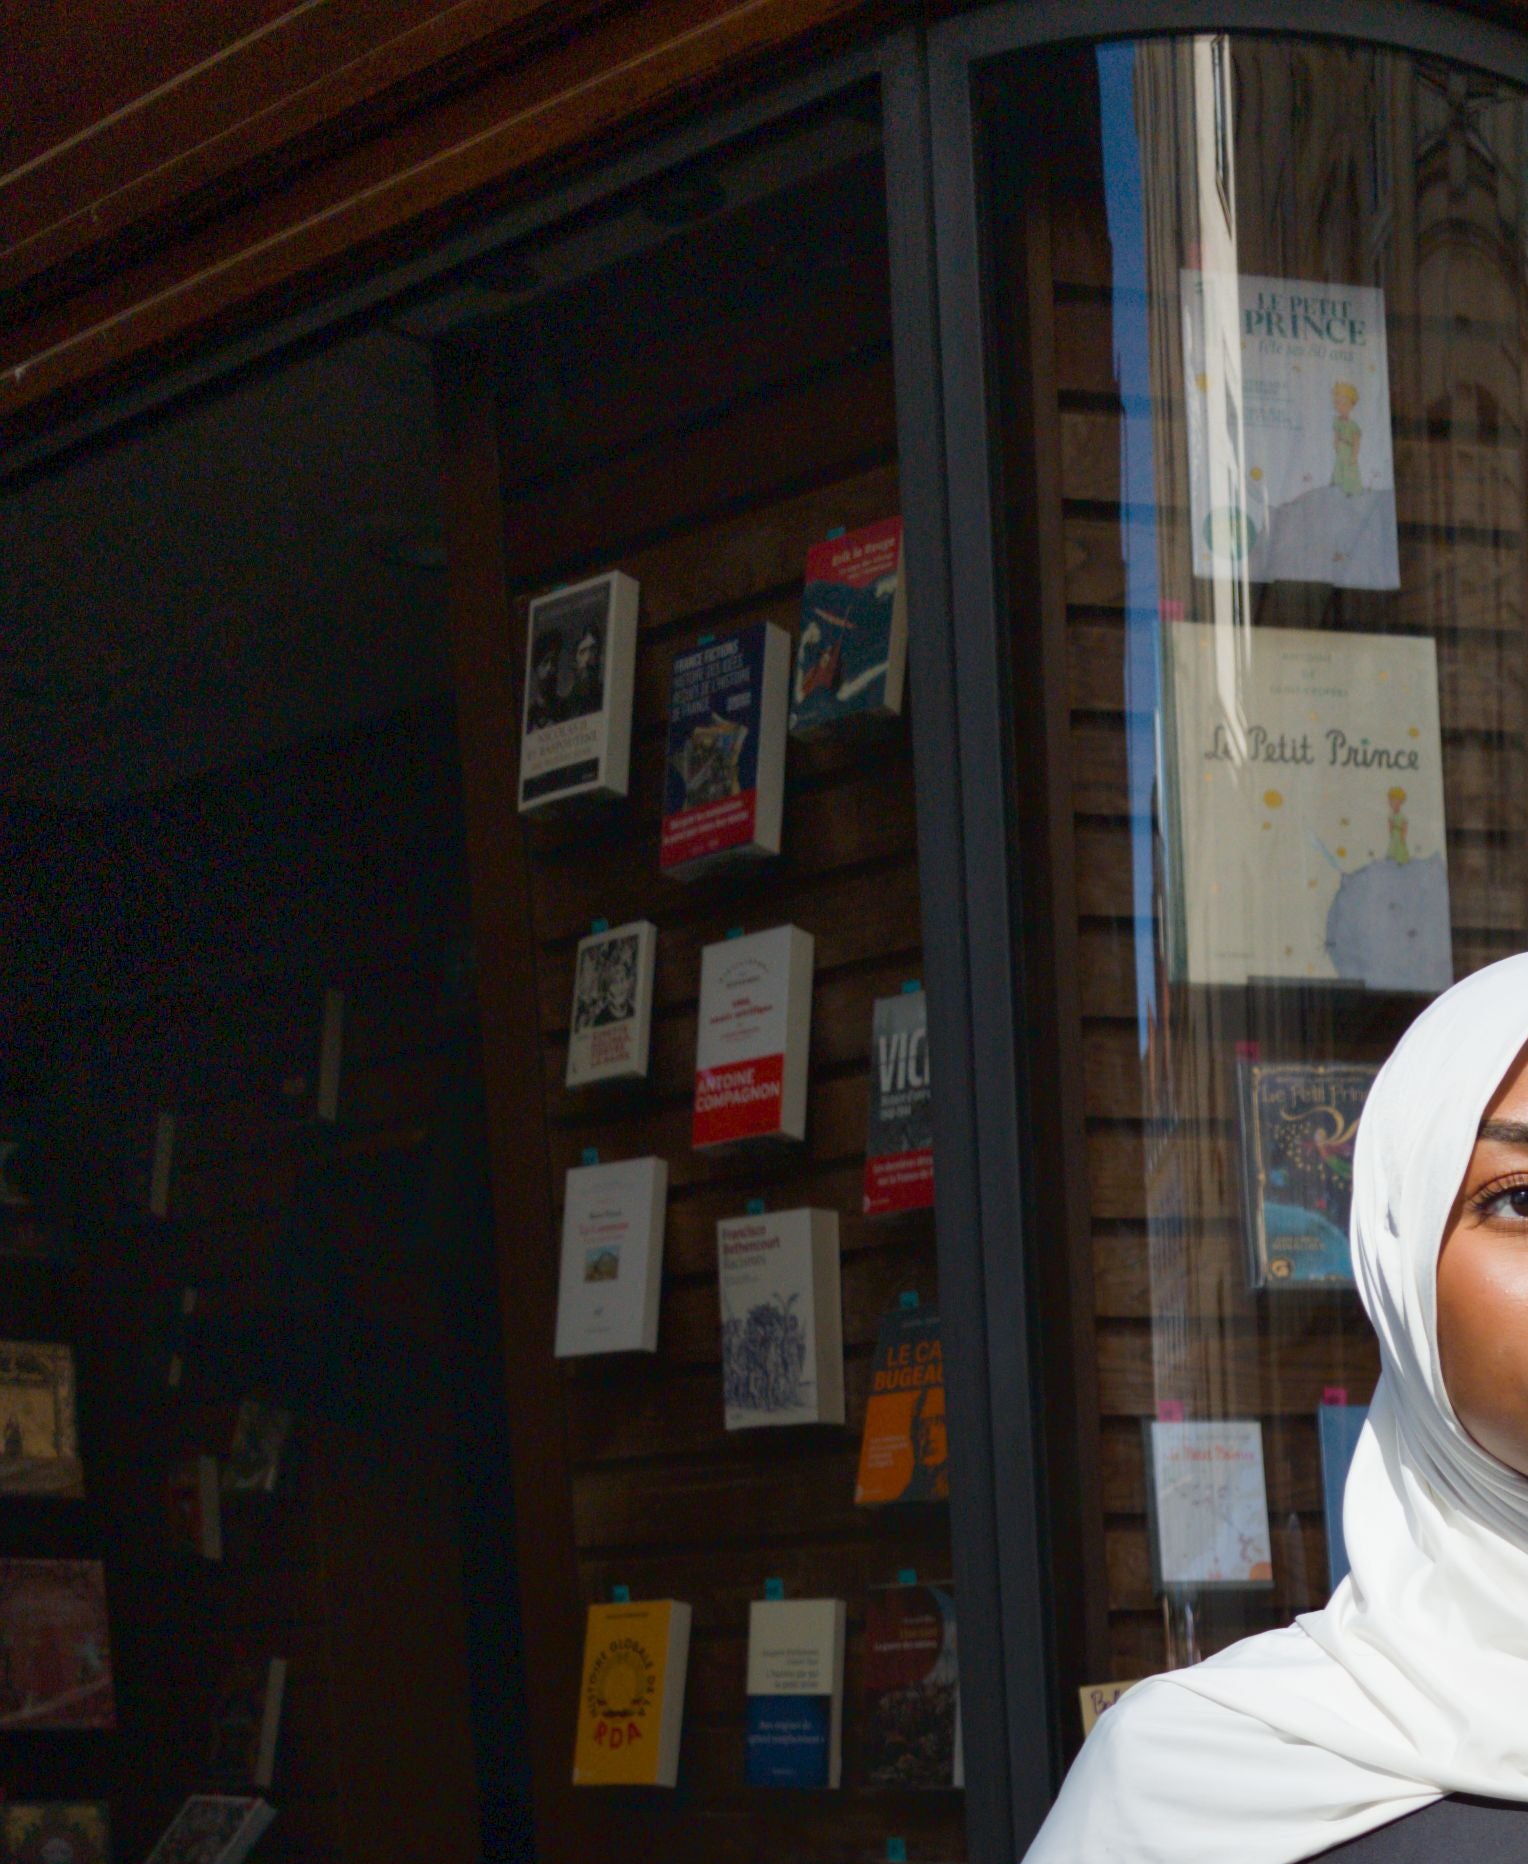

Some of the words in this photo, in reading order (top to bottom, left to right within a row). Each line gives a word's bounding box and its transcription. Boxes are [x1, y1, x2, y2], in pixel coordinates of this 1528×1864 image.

[1258, 292, 1277, 311] LE
[1290, 296, 1352, 318] PETIT
[1245, 309, 1366, 346] PRINCE
[1248, 726, 1314, 766] Petit
[1325, 729, 1419, 771] Prince
[697, 1068, 755, 1095] ANTOINE
[696, 1081, 781, 1113] COMPAGNON
[887, 1344, 912, 1367] LE
[915, 1339, 943, 1364] CA
